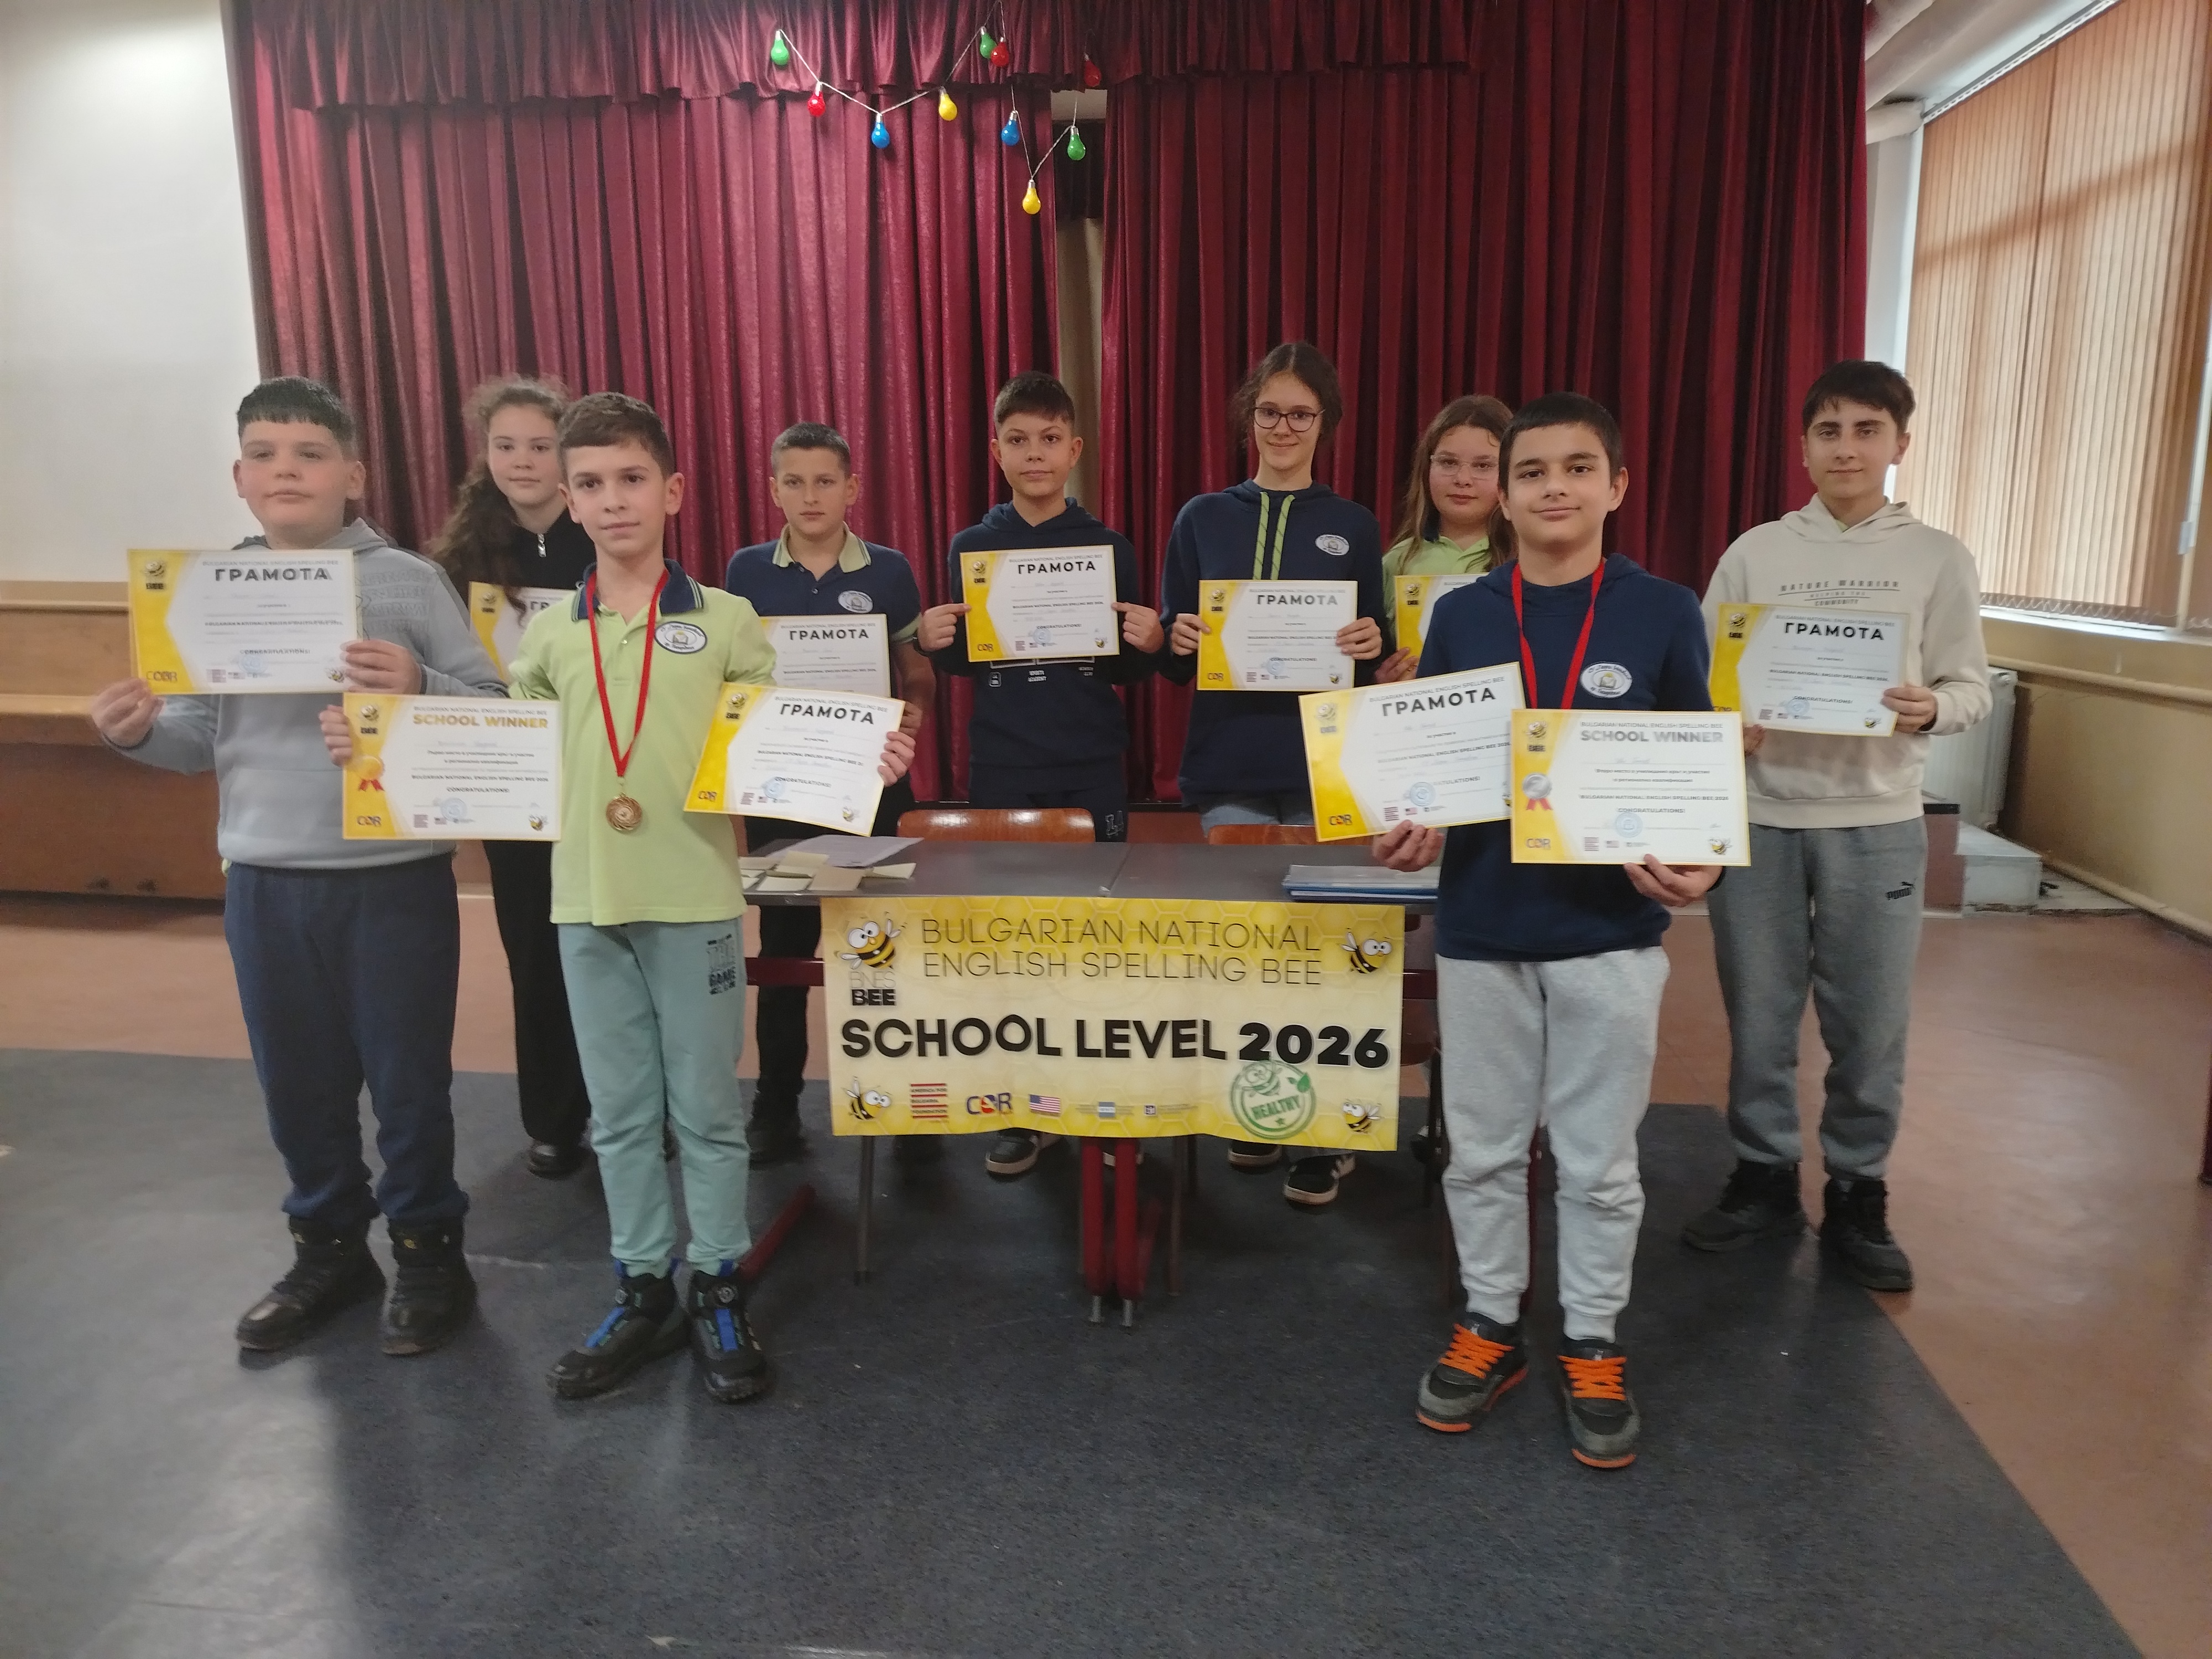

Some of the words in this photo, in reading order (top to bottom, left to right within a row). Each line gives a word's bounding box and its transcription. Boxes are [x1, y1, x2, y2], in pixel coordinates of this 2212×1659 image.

[215, 568, 332, 581] ГРАМОТА
[1018, 561, 1096, 575] ГРАМОТА
[1781, 581, 1829, 591] NATURE
[1258, 594, 1338, 605] ГРАМОТА
[789, 629, 869, 640] ГРАМОТА
[1785, 622, 1884, 640] ГРАМОТА
[1369, 693, 1403, 702] BULGARIAN
[1405, 688, 1434, 697] NATIONAL
[1383, 687, 1496, 716] ГРАМОТА
[413, 714, 480, 726] SCHOOL
[484, 716, 548, 728] WINNER
[780, 703, 874, 724] ГРАМОТА
[1581, 730, 1649, 742] SCHOOL
[1653, 731, 1723, 743] WINNER
[921, 917, 1123, 943] BULGARIAN
[1139, 920, 1321, 951] NATIONAL
[924, 951, 1067, 977] ENGLISH
[1082, 952, 1246, 982] SPELLING
[1261, 958, 1321, 985] BEE
[849, 971, 896, 988] BNES
[852, 989, 895, 1006] BEE
[841, 1014, 1062, 1058] SCHOOL
[1076, 1019, 1227, 1060] LEVEL
[1239, 1022, 1390, 1069] 2026
[1251, 1095, 1300, 1120] HEALTHY
